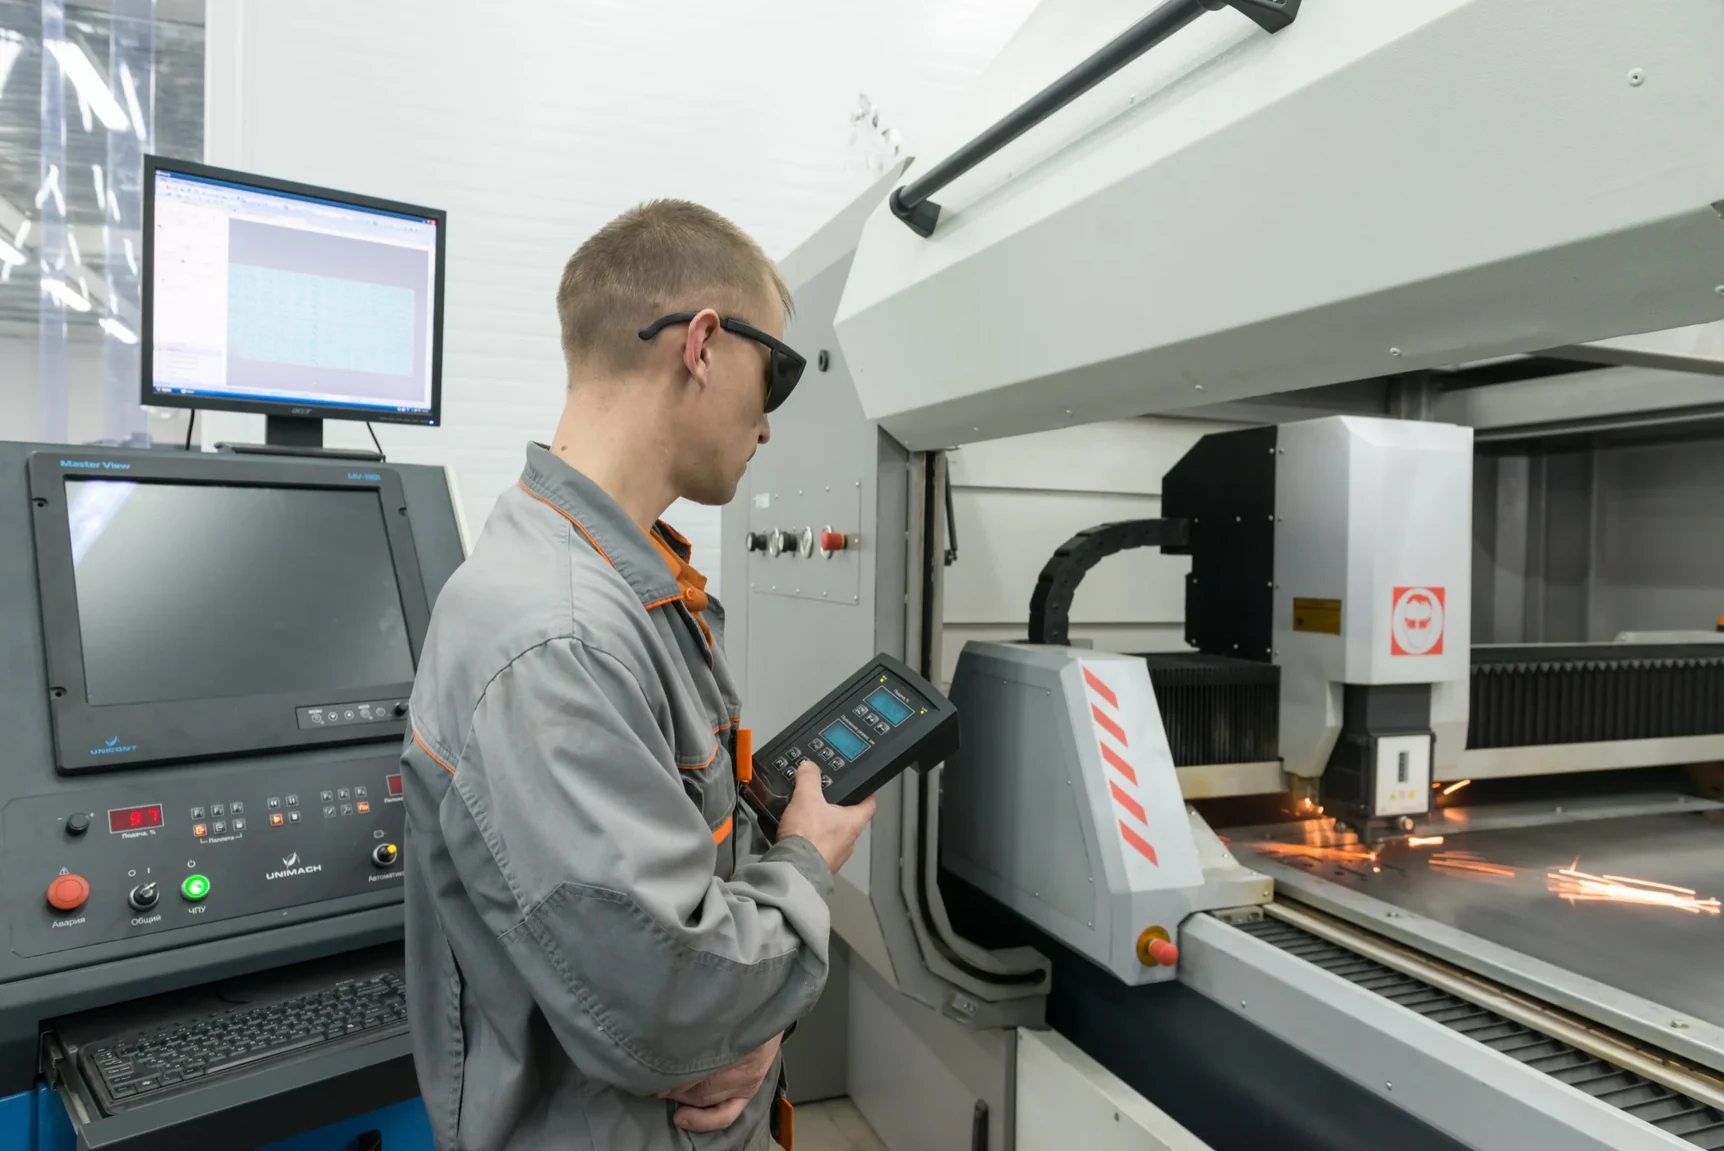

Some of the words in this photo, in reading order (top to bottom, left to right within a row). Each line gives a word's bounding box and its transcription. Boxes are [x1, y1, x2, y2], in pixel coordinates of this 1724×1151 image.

[59, 459, 100, 469] Master
[102, 461, 131, 470] View
[90, 744, 137, 755] UNICONT
[130, 807, 160, 827] 97
[265, 863, 322, 880] UNIMACH
[188, 905, 207, 915] ЧПУ
[51, 916, 86, 929] Авария
[130, 914, 162, 926] Общий
